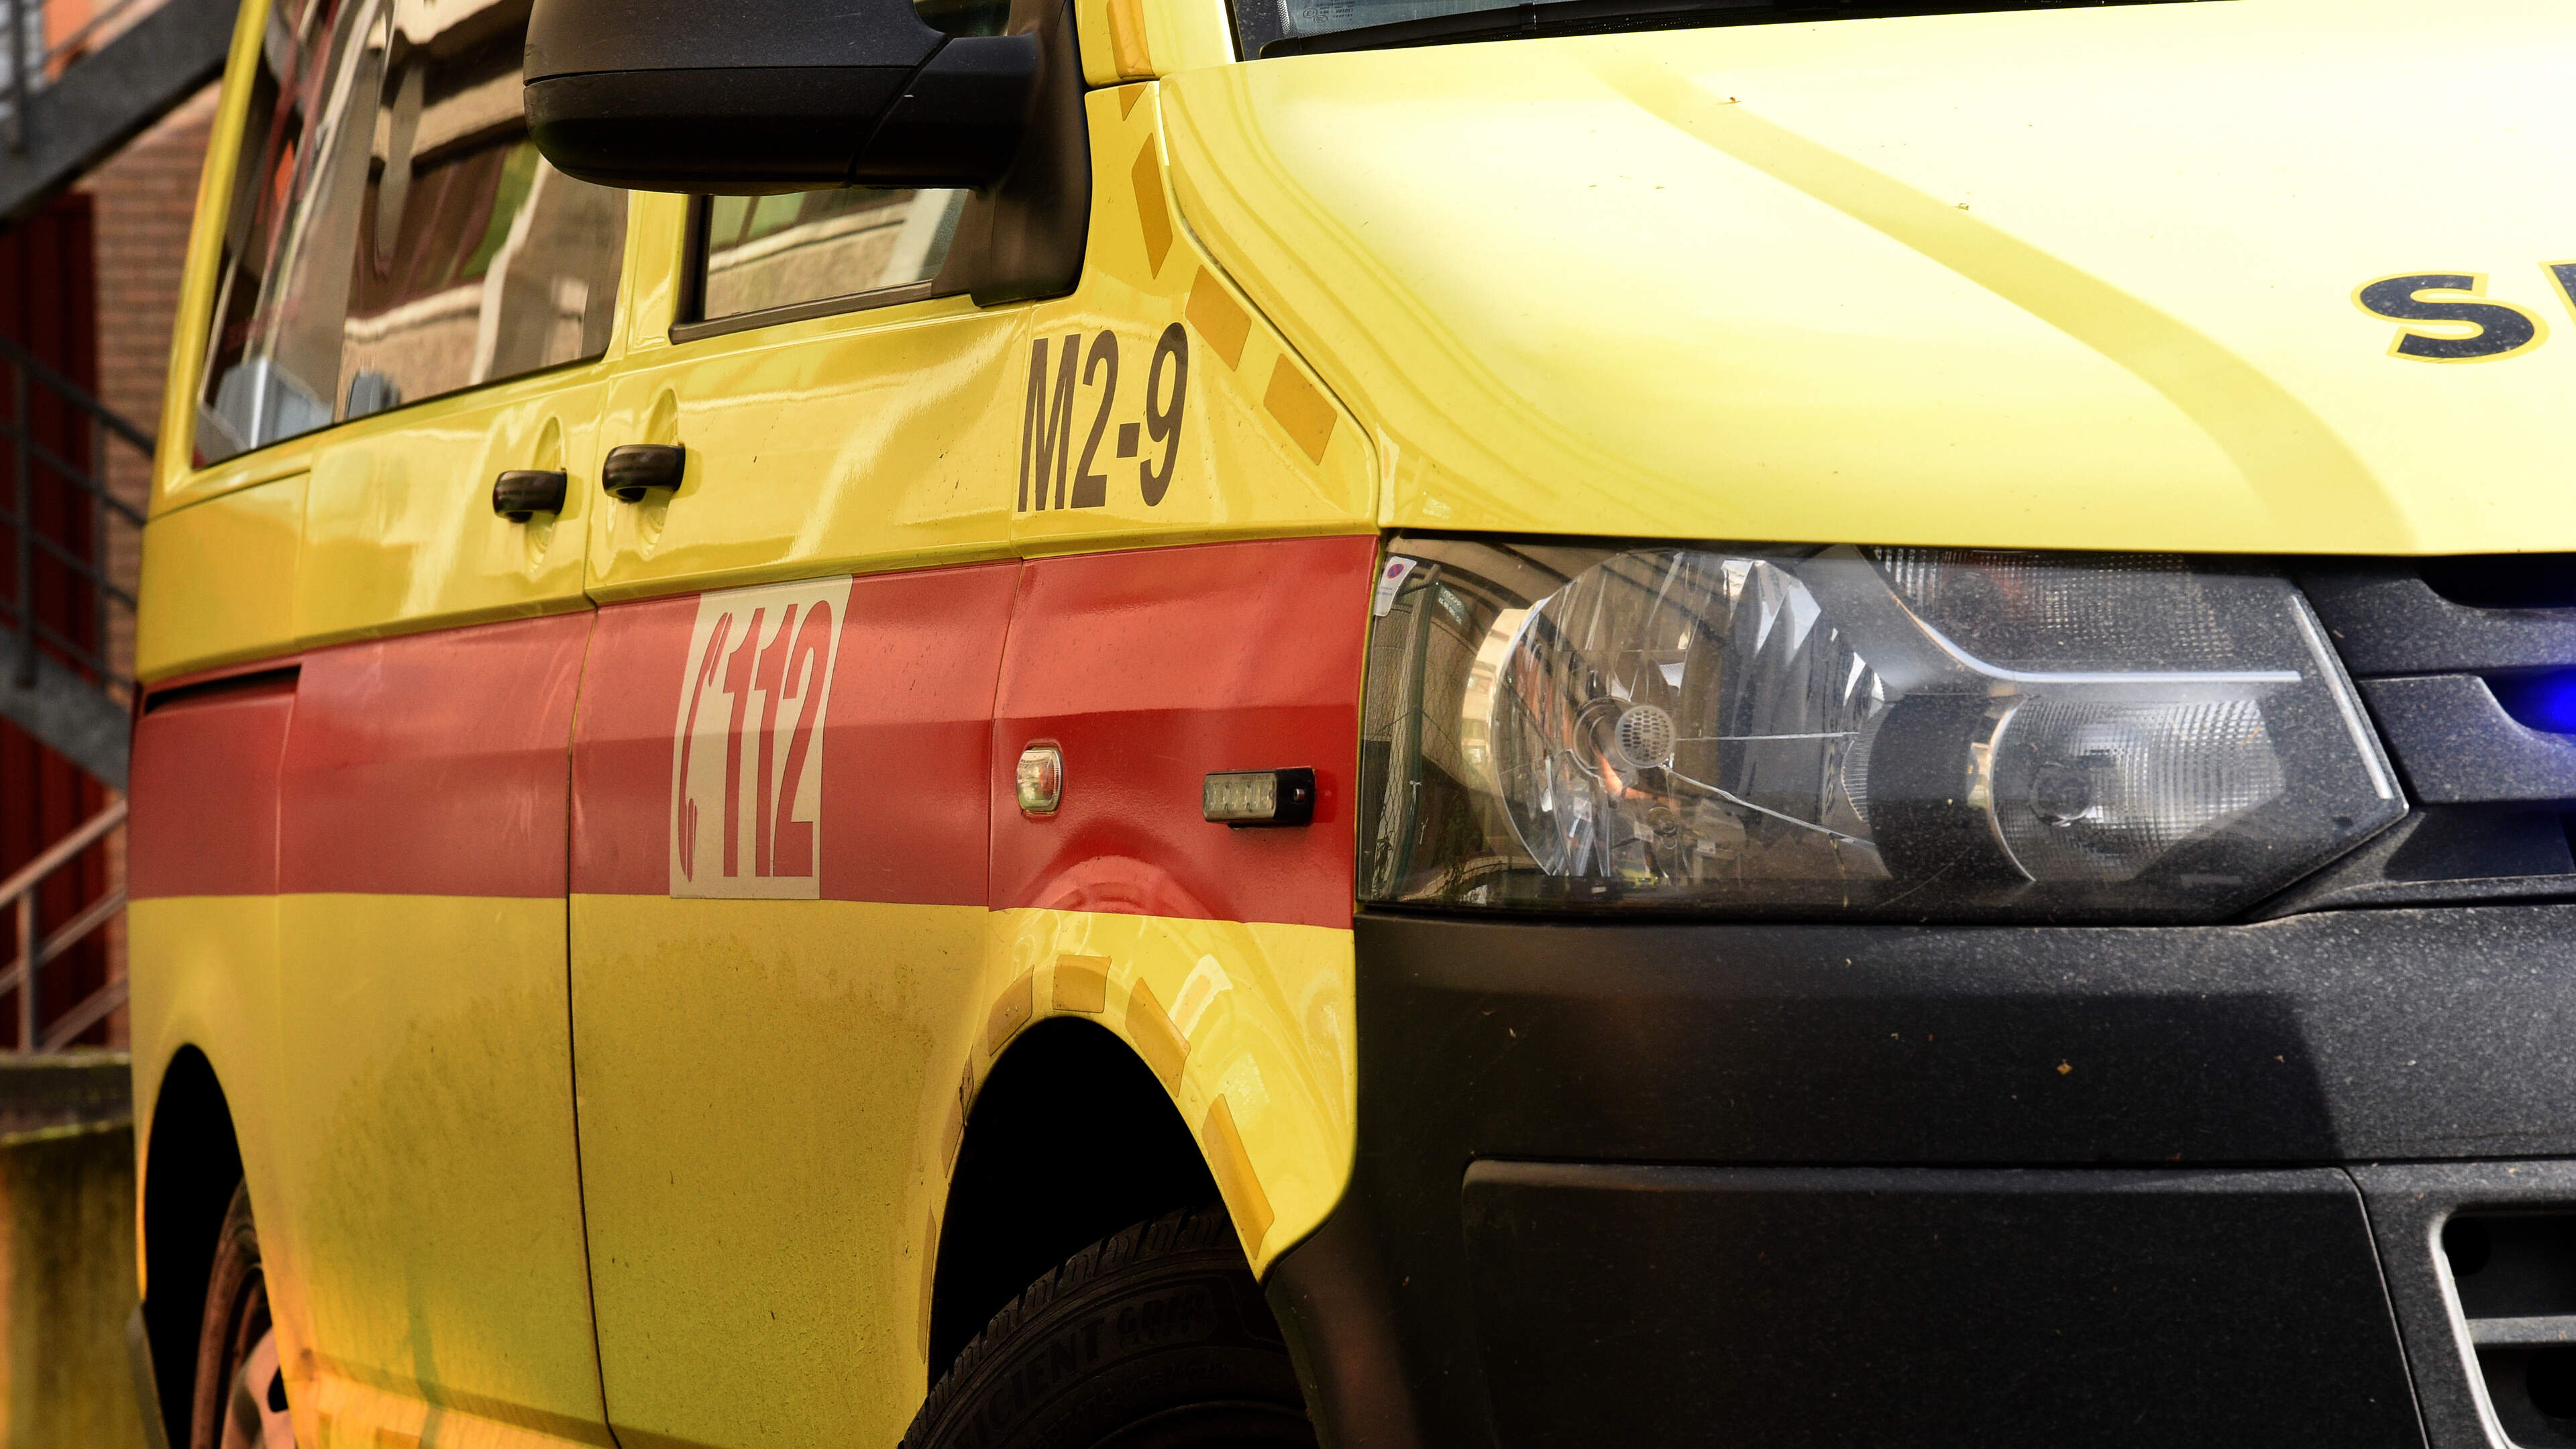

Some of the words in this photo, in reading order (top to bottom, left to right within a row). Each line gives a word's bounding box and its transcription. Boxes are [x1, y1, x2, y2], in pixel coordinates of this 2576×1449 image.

[2353, 260, 2576, 363] S
[1017, 321, 1189, 513] M2-9
[722, 599, 833, 877] 112
